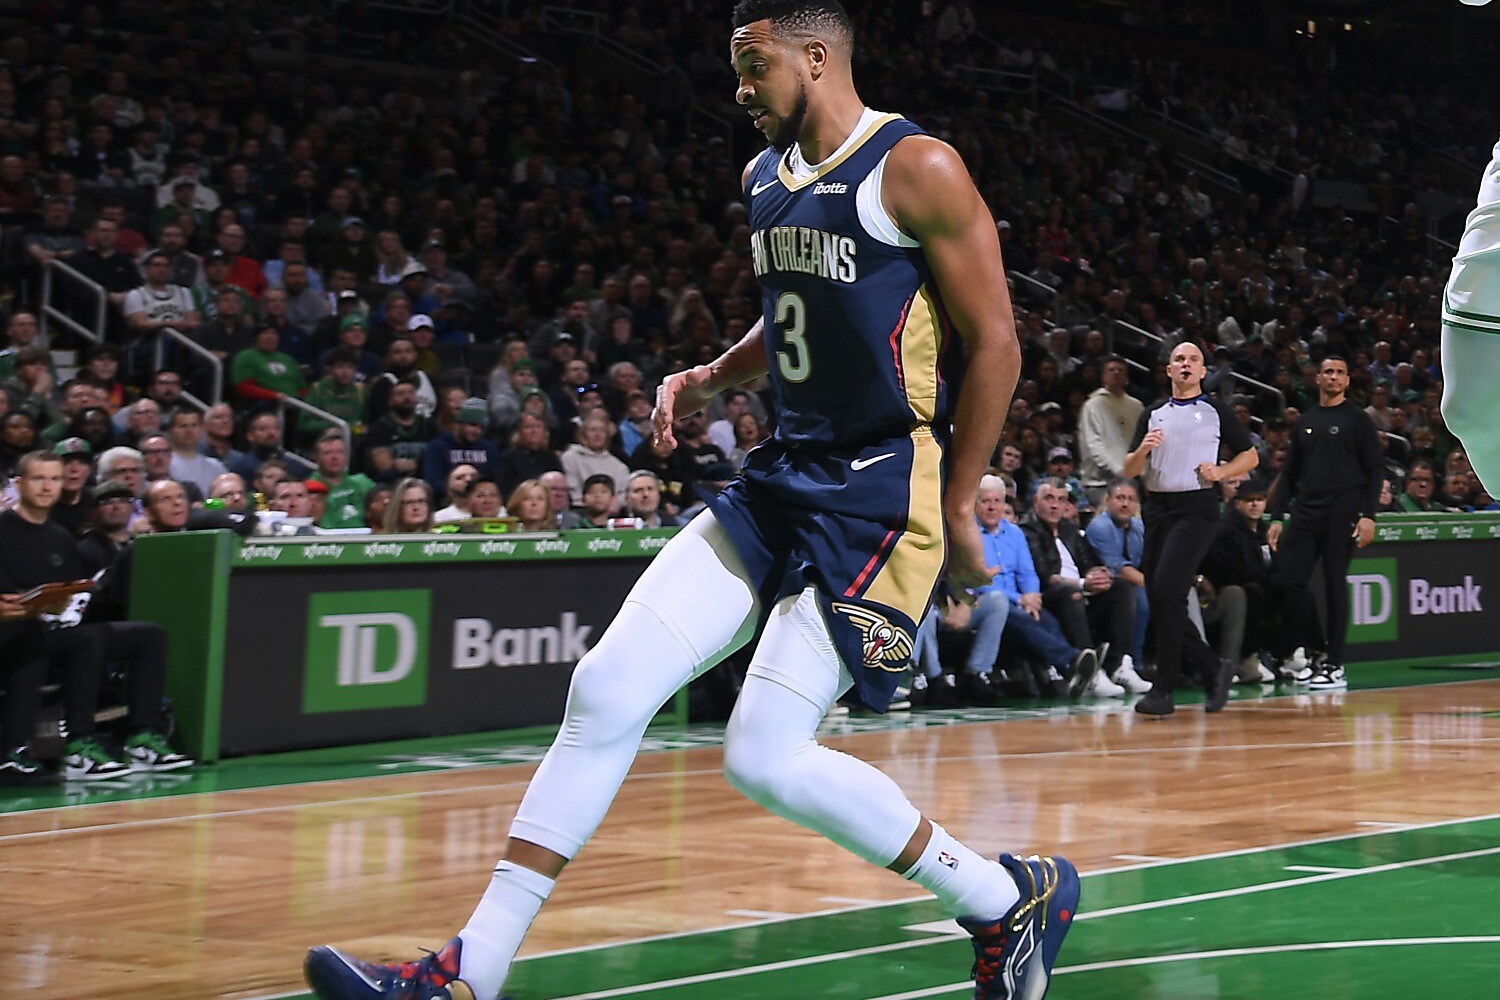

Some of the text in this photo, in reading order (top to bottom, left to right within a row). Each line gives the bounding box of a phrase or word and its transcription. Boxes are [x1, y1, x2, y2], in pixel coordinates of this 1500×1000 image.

[813, 182, 847, 195] ibotta
[770, 227, 857, 283] ORLEANS
[774, 291, 812, 383] 3
[1408, 575, 1482, 616] Bank
[320, 611, 592, 688] TD Bank
